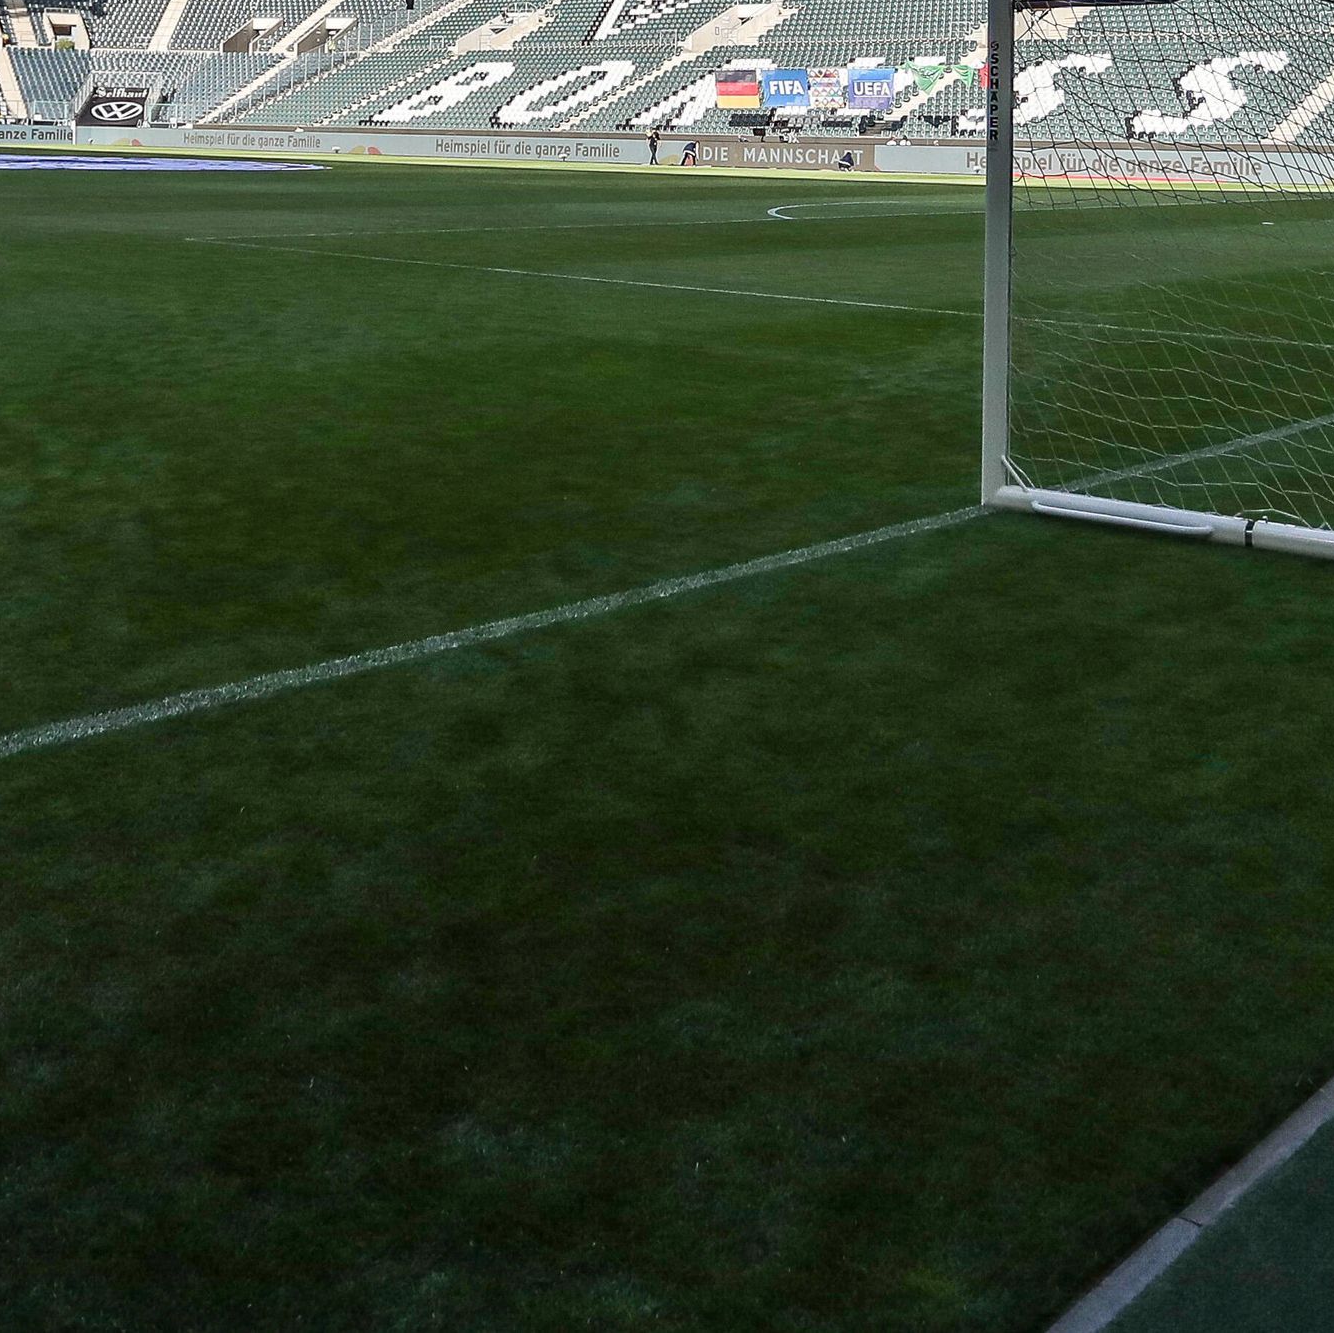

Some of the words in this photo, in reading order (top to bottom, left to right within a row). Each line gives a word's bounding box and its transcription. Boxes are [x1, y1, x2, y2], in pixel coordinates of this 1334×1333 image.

[768, 78, 805, 96] FIFA
[853, 81, 891, 97] UEFA
[989, 52, 1000, 141] SCHÄPER
[31, 129, 74, 142] Familie
[183, 132, 225, 148] Heimspiel
[227, 133, 240, 146] für
[241, 134, 254, 147] die
[256, 137, 285, 150] ganze
[287, 135, 321, 148] Familie
[435, 138, 490, 156] Heimspiel
[493, 139, 509, 154] für
[514, 140, 532, 155] die
[535, 144, 571, 159] ganze
[575, 142, 620, 158] Familie
[702, 146, 729, 161] DIE
[1058, 152, 1088, 171] für
[1092, 153, 1121, 173] die
[1126, 159, 1183, 180] ganze
[1189, 156, 1262, 177] Familie
